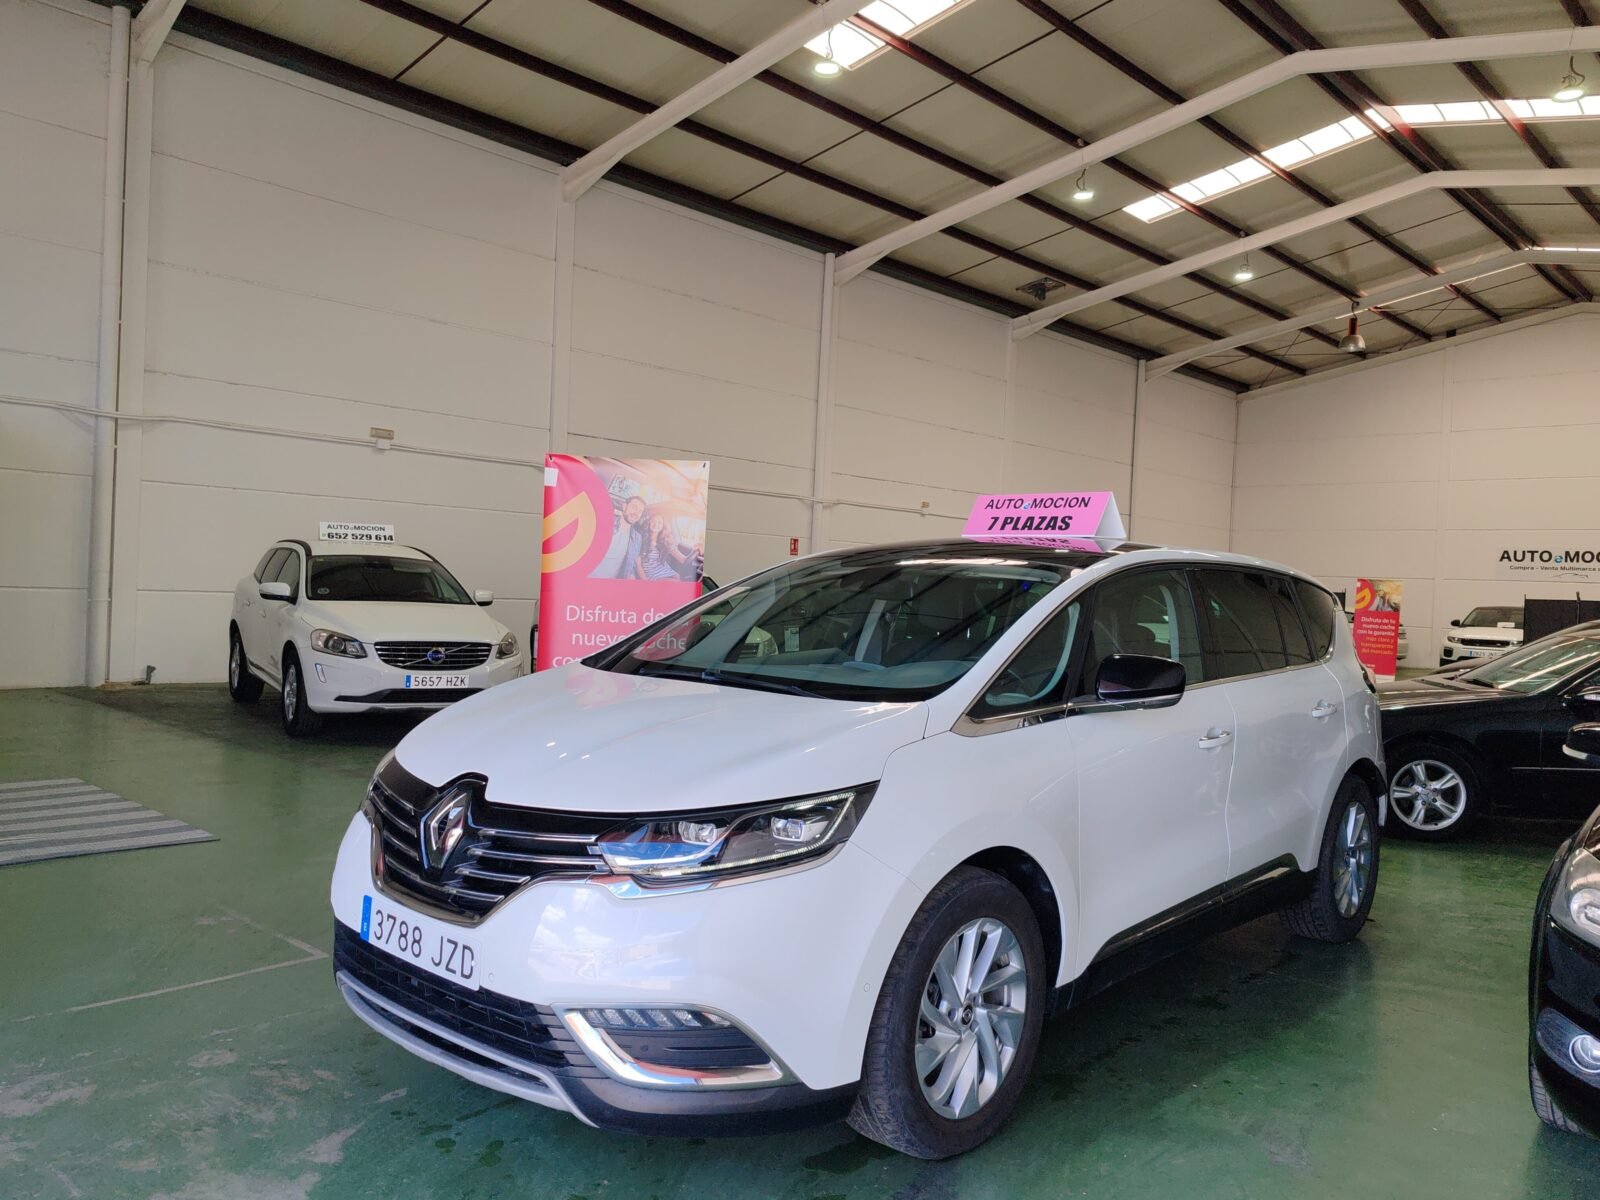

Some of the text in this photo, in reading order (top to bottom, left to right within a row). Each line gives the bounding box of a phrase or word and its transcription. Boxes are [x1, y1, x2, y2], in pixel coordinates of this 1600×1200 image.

[987, 515, 1073, 531] 7 PLAZAS
[327, 532, 394, 542] 652 529 614
[566, 605, 637, 624] Disfruta
[552, 656, 578, 669] co
[414, 676, 466, 687] 5657 HZK
[374, 909, 475, 980] 3788 JZD
